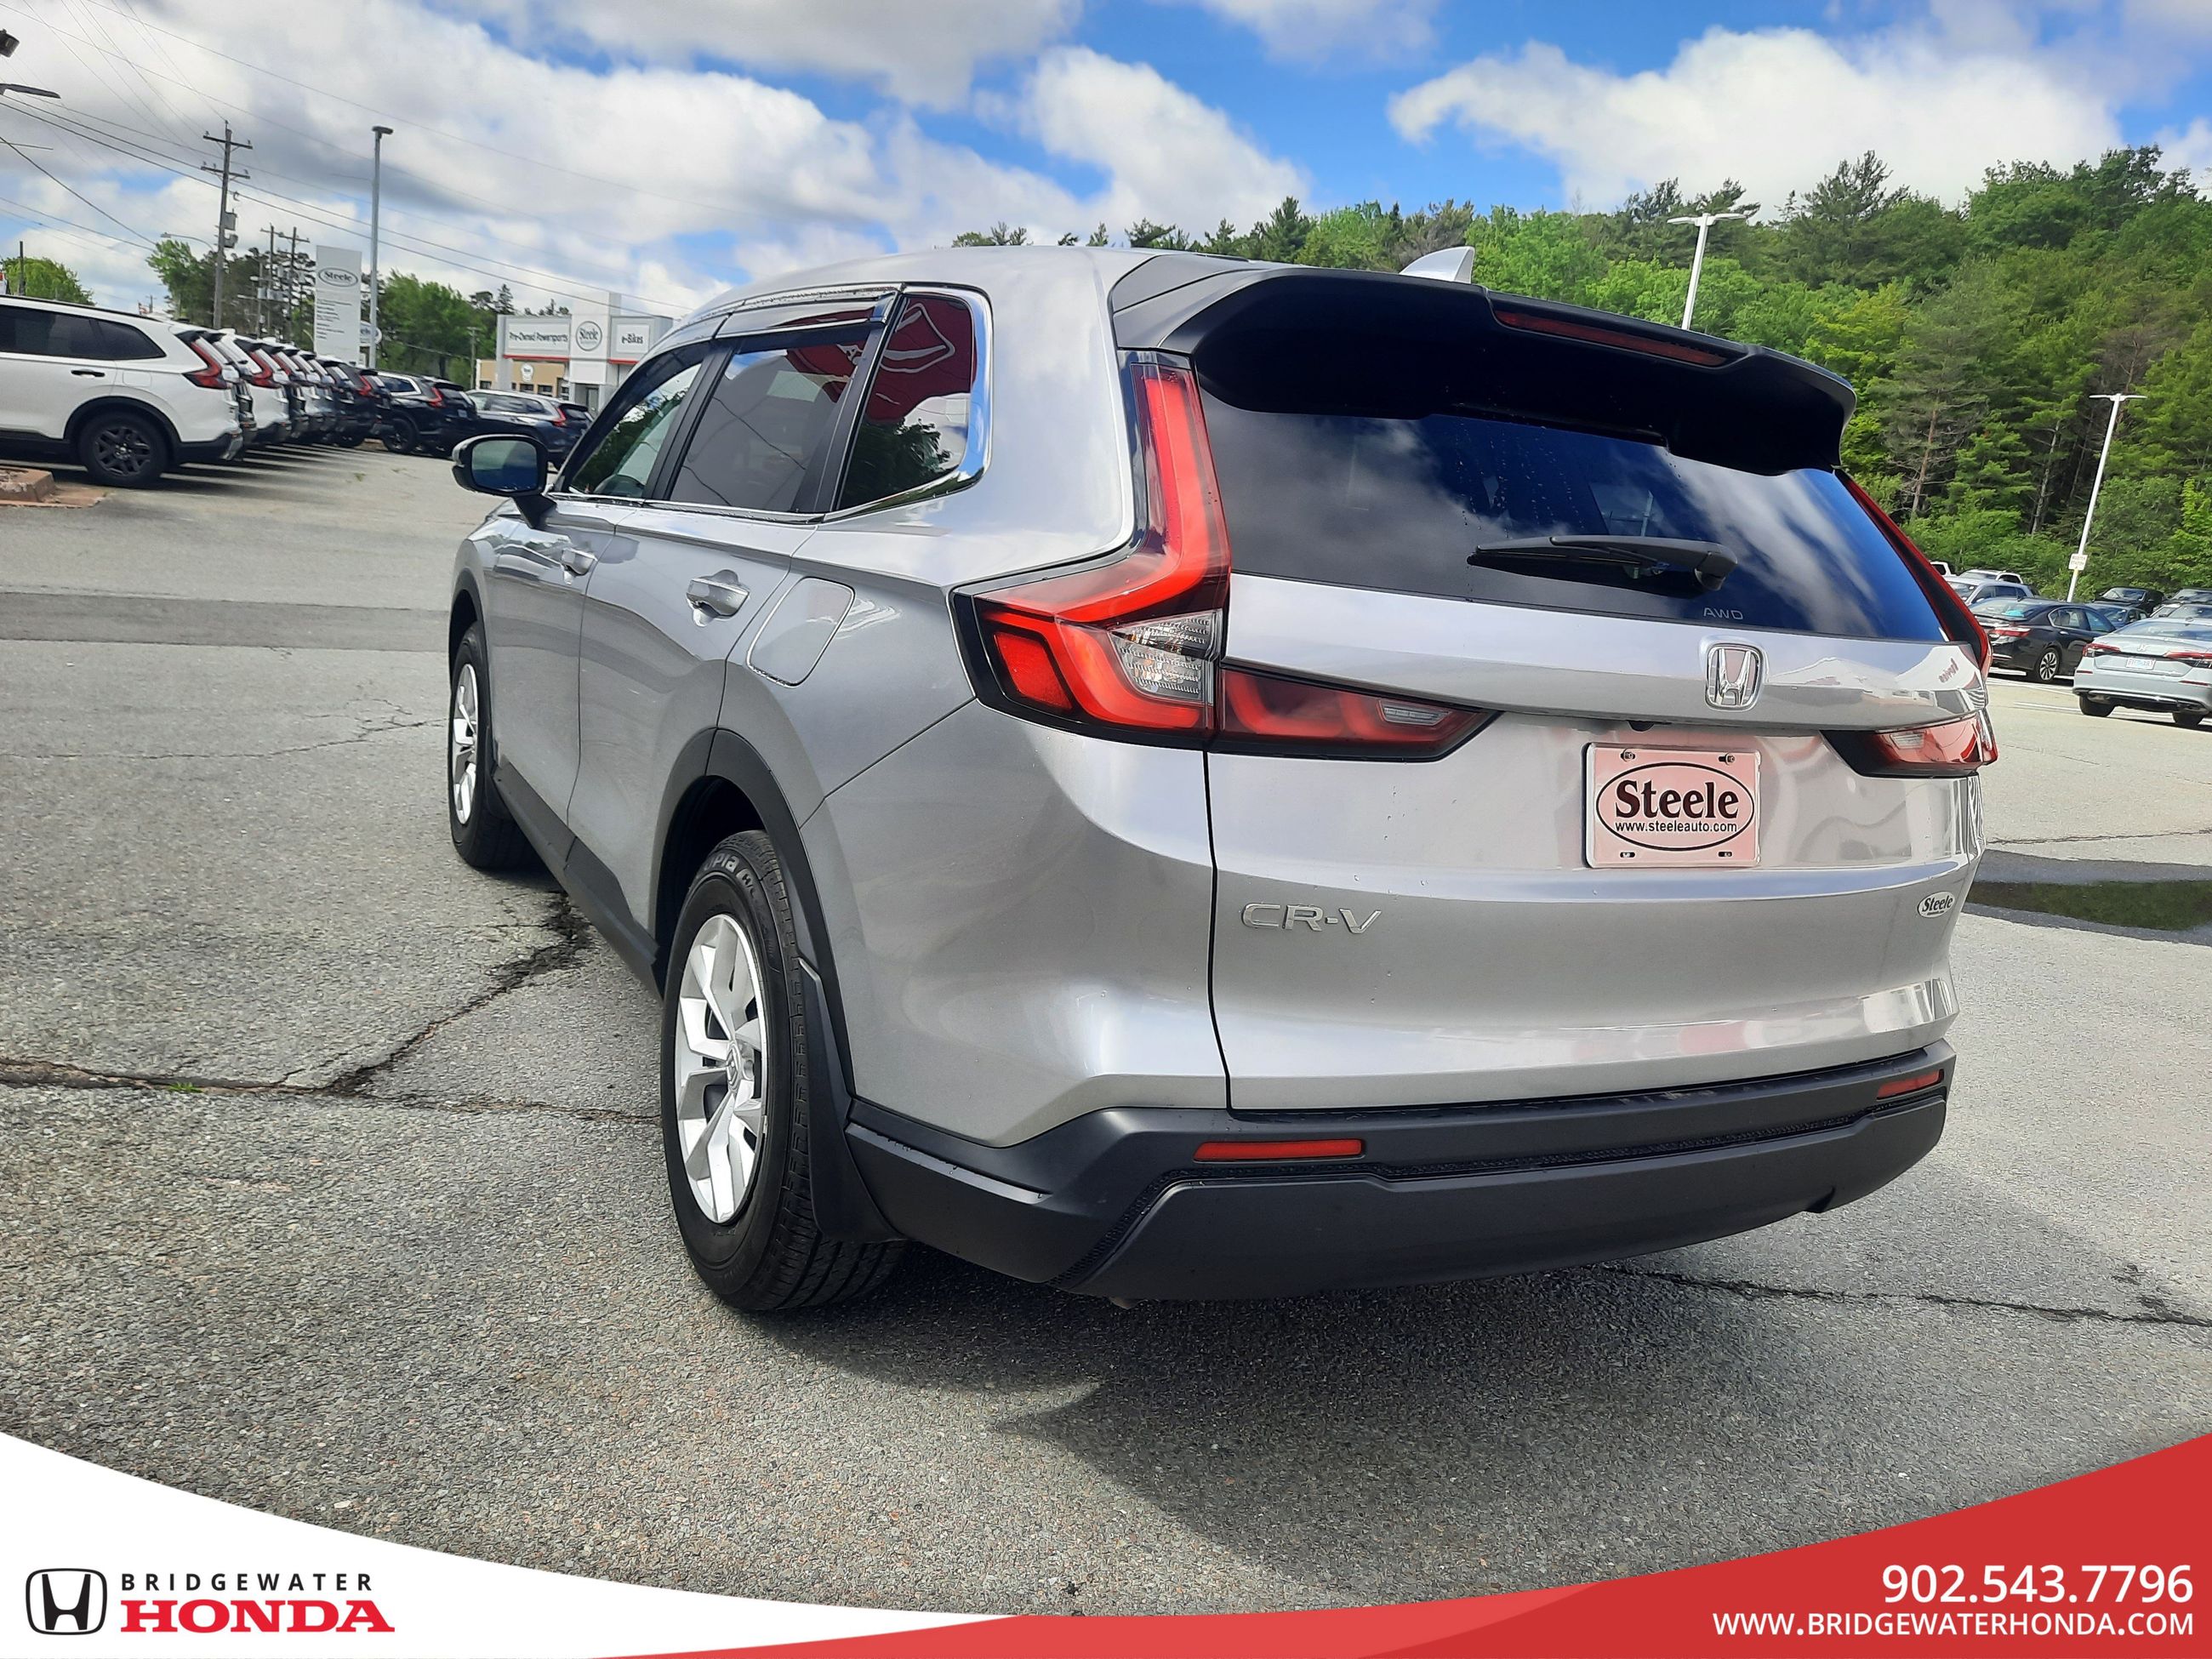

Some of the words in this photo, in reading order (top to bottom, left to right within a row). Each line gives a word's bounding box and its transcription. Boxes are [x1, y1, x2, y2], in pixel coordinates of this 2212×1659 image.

[1703, 607, 1743, 620] AWD
[1616, 779, 1739, 819] Steele
[1615, 820, 1738, 833] www.steeleauto.com
[1921, 895, 1953, 912] Steele
[1241, 902, 1382, 934] CR-V
